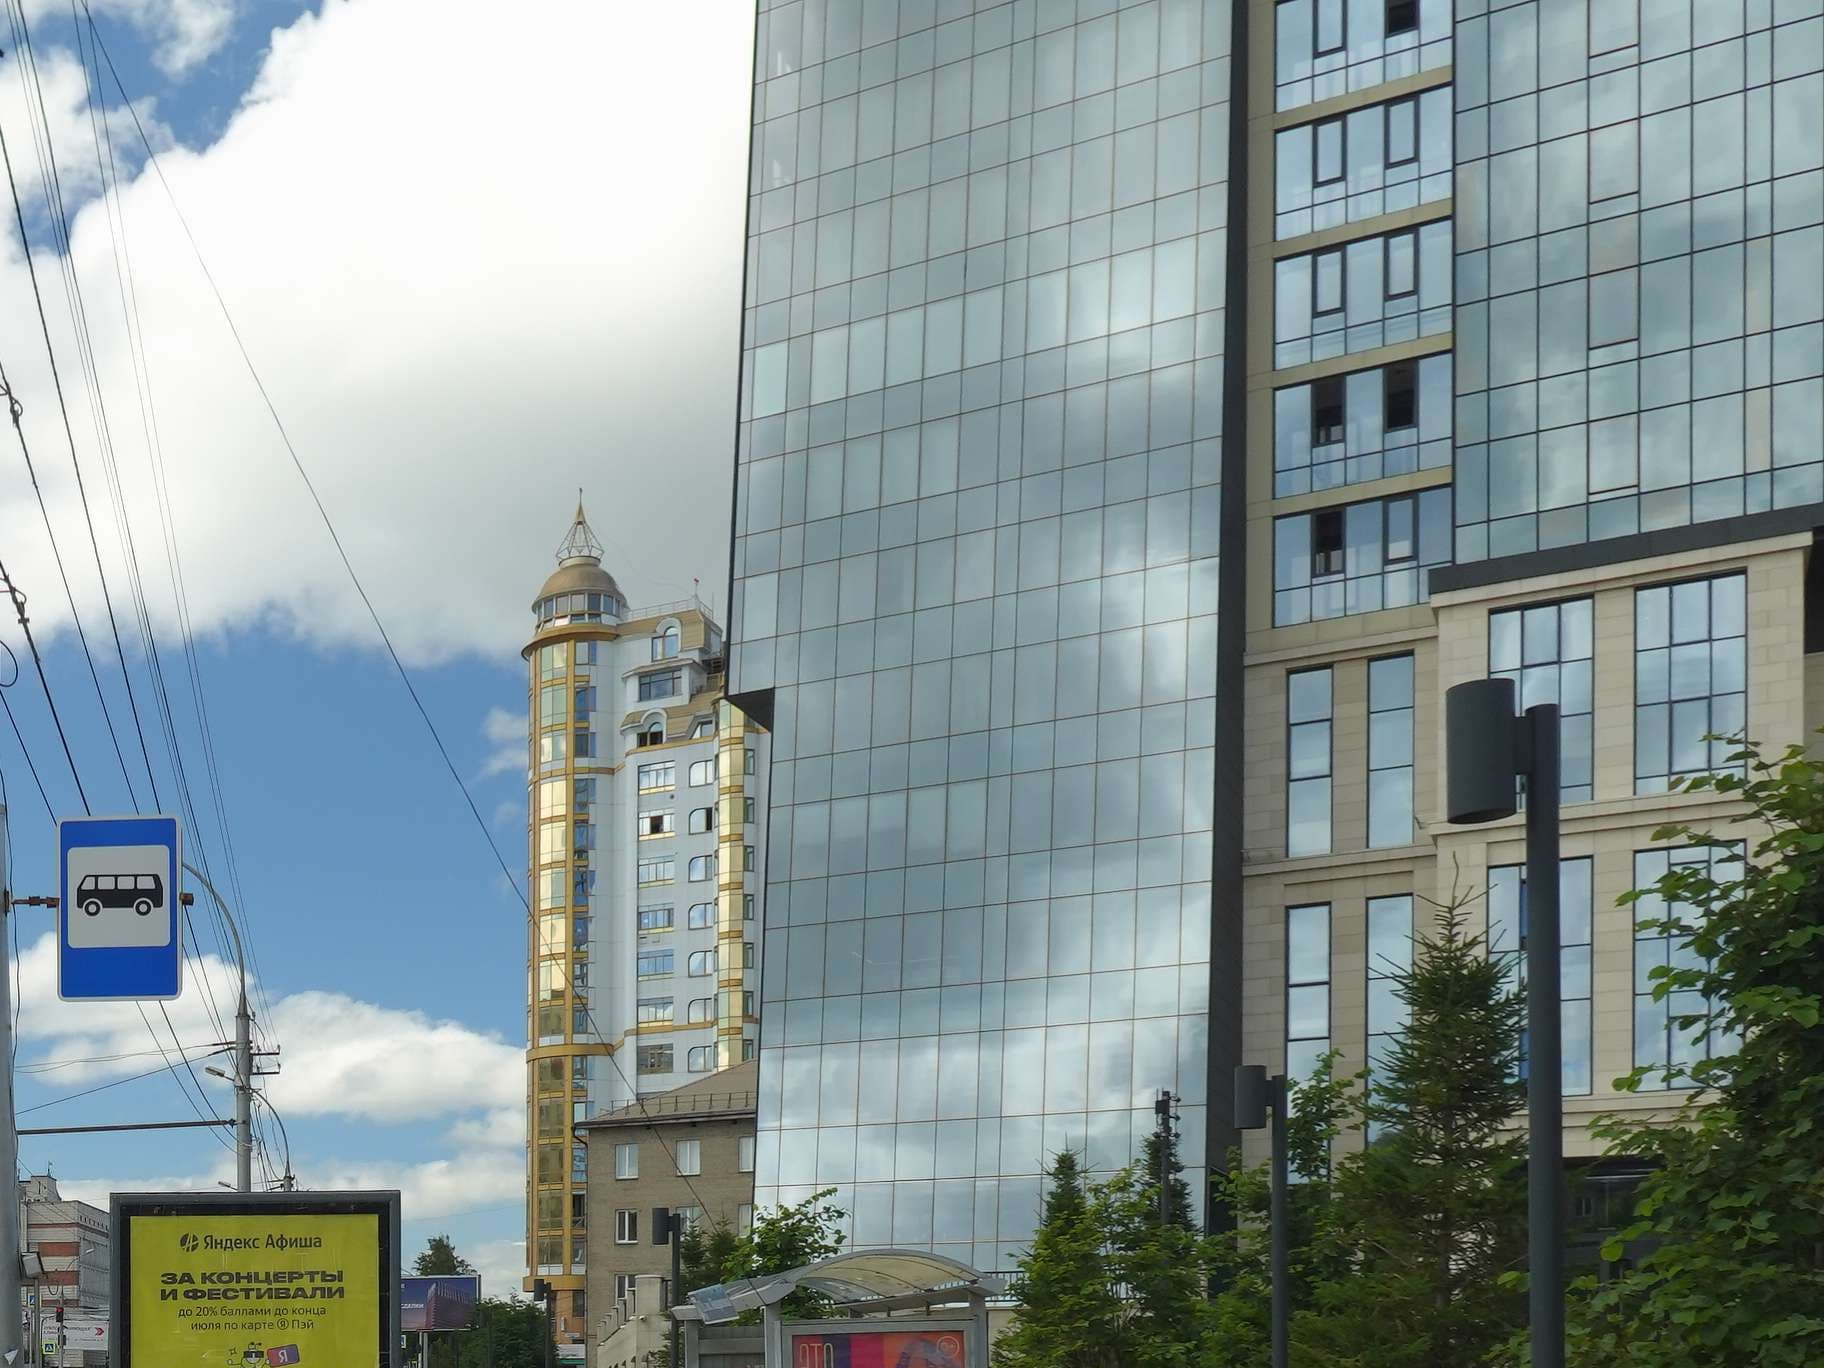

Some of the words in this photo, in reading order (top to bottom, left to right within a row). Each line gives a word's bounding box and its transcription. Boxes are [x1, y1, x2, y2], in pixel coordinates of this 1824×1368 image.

[204, 1234, 260, 1251] Яндекс
[265, 1233, 322, 1251] Афиша
[160, 1272, 196, 1284] ЗА
[200, 1270, 344, 1285] КОНЦЕРТЫ
[160, 1288, 178, 1301] И
[183, 1286, 345, 1301] ФЕСТИВАЛИ
[178, 1308, 193, 1318] до
[196, 1306, 217, 1317] 20%
[220, 1305, 271, 1317] баллами
[274, 1307, 289, 1318] до
[291, 1306, 326, 1317] конца
[191, 1320, 221, 1331] июля
[224, 1321, 238, 1331] по
[241, 1320, 274, 1332] карте
[291, 1319, 314, 1329] Пэй
